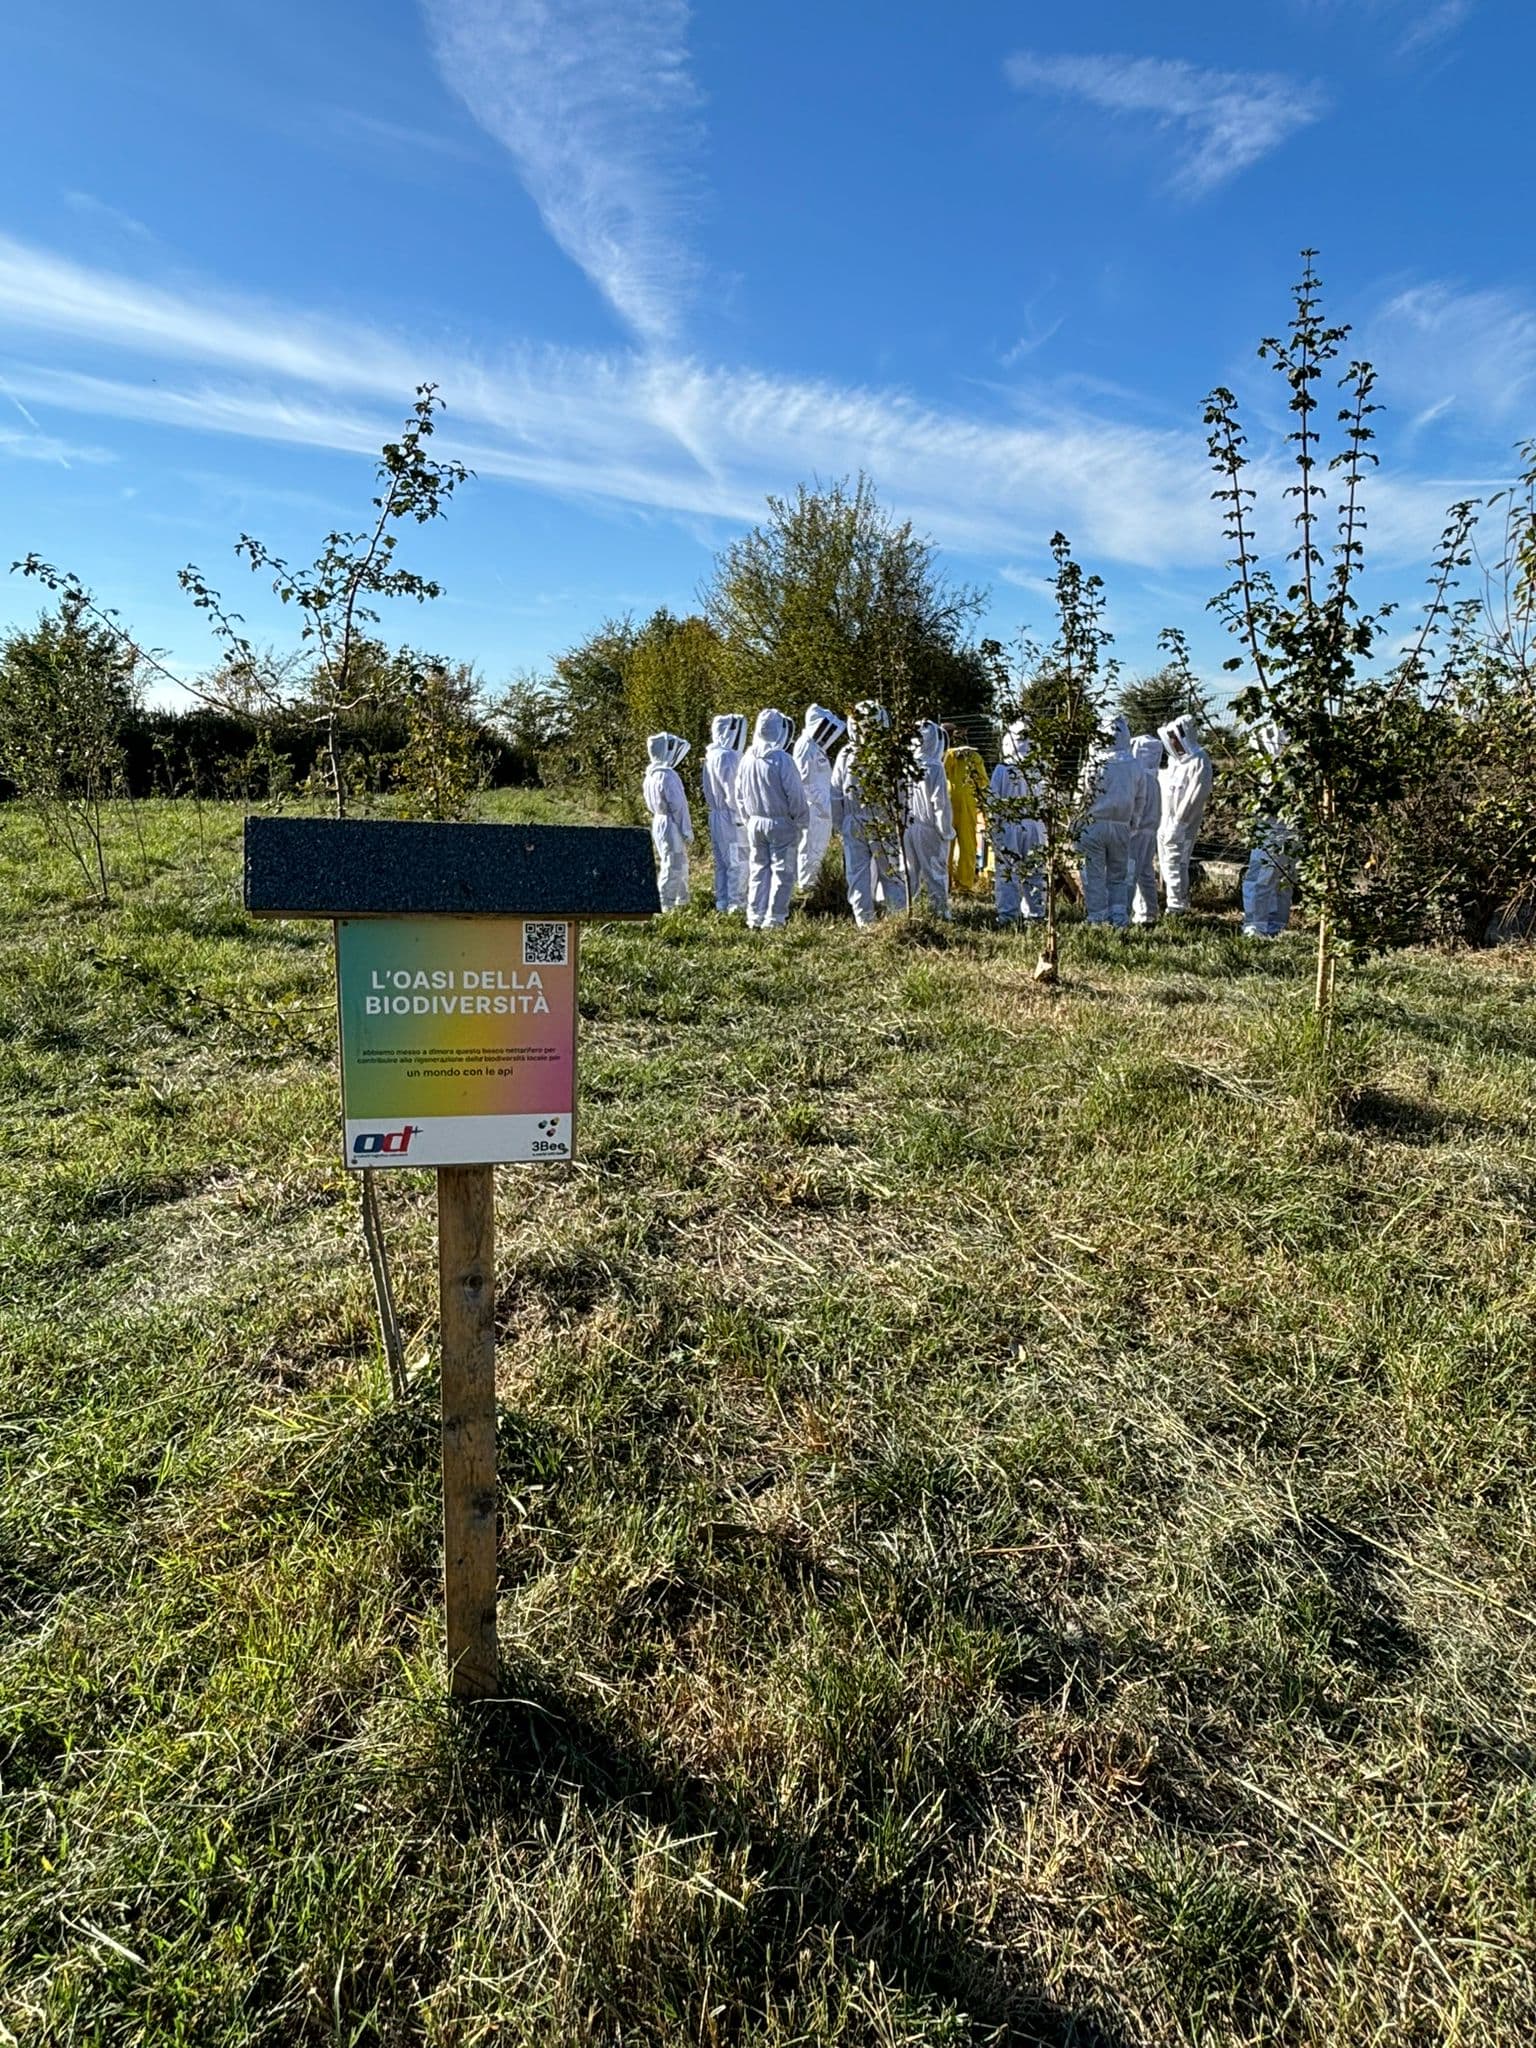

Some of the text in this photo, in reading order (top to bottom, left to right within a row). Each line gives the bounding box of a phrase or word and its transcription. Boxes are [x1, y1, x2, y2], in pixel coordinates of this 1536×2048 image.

[372, 970, 544, 990] L'OASI DELLA
[366, 991, 550, 1015] BIODIVERSITÀ
[429, 1047, 454, 1055] dimora
[407, 1066, 514, 1077] un mondo con le api
[532, 1141, 567, 1152] 3Bee
